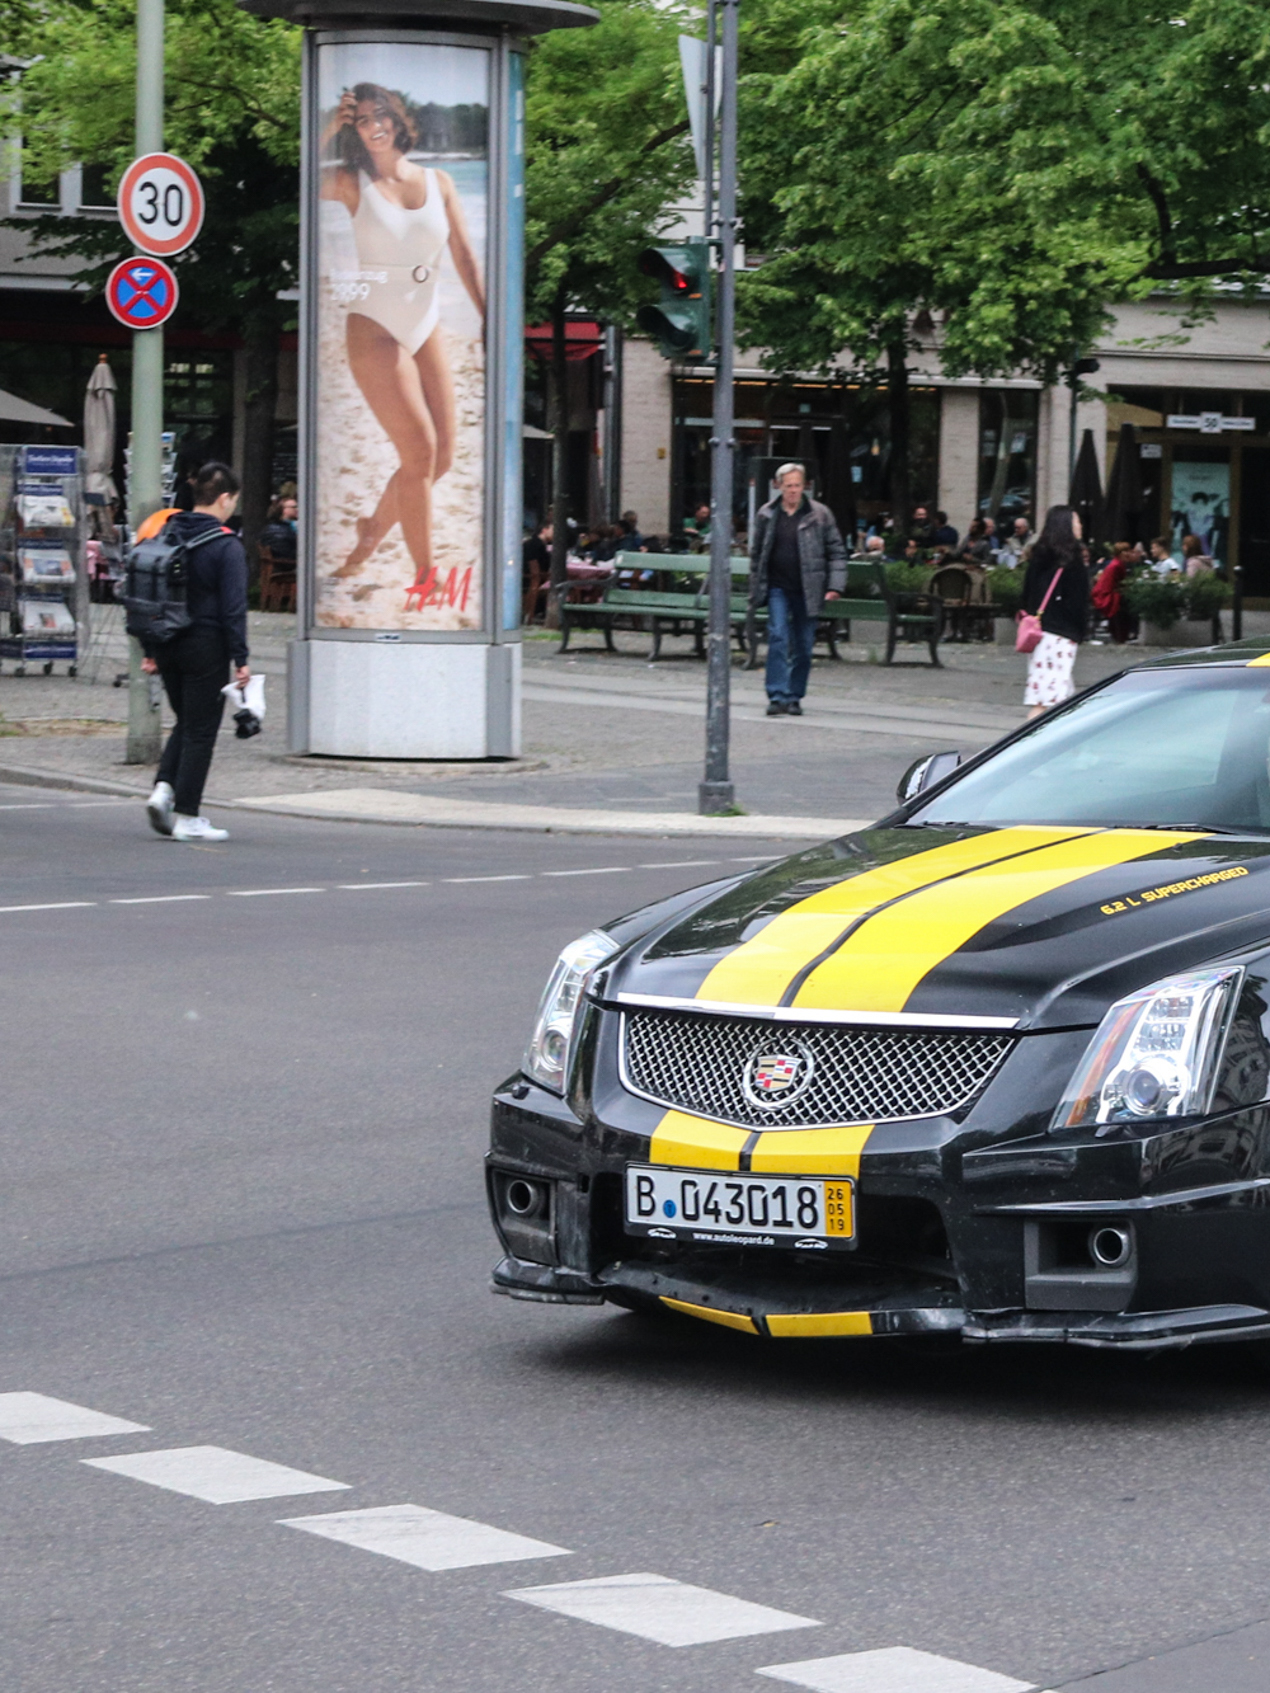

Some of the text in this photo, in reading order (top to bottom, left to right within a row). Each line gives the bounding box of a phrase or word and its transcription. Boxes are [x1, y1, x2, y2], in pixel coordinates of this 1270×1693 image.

[138, 181, 184, 227] 30
[402, 565, 473, 613] H&M
[1100, 866, 1249, 916] 6.2 L SUPERCHARGED
[636, 1174, 819, 1230] B 043018
[827, 1188, 844, 1200] 26
[828, 1203, 845, 1216] 05
[692, 1230, 776, 1247] www.autoleopard.de
[829, 1218, 845, 1231] 19
